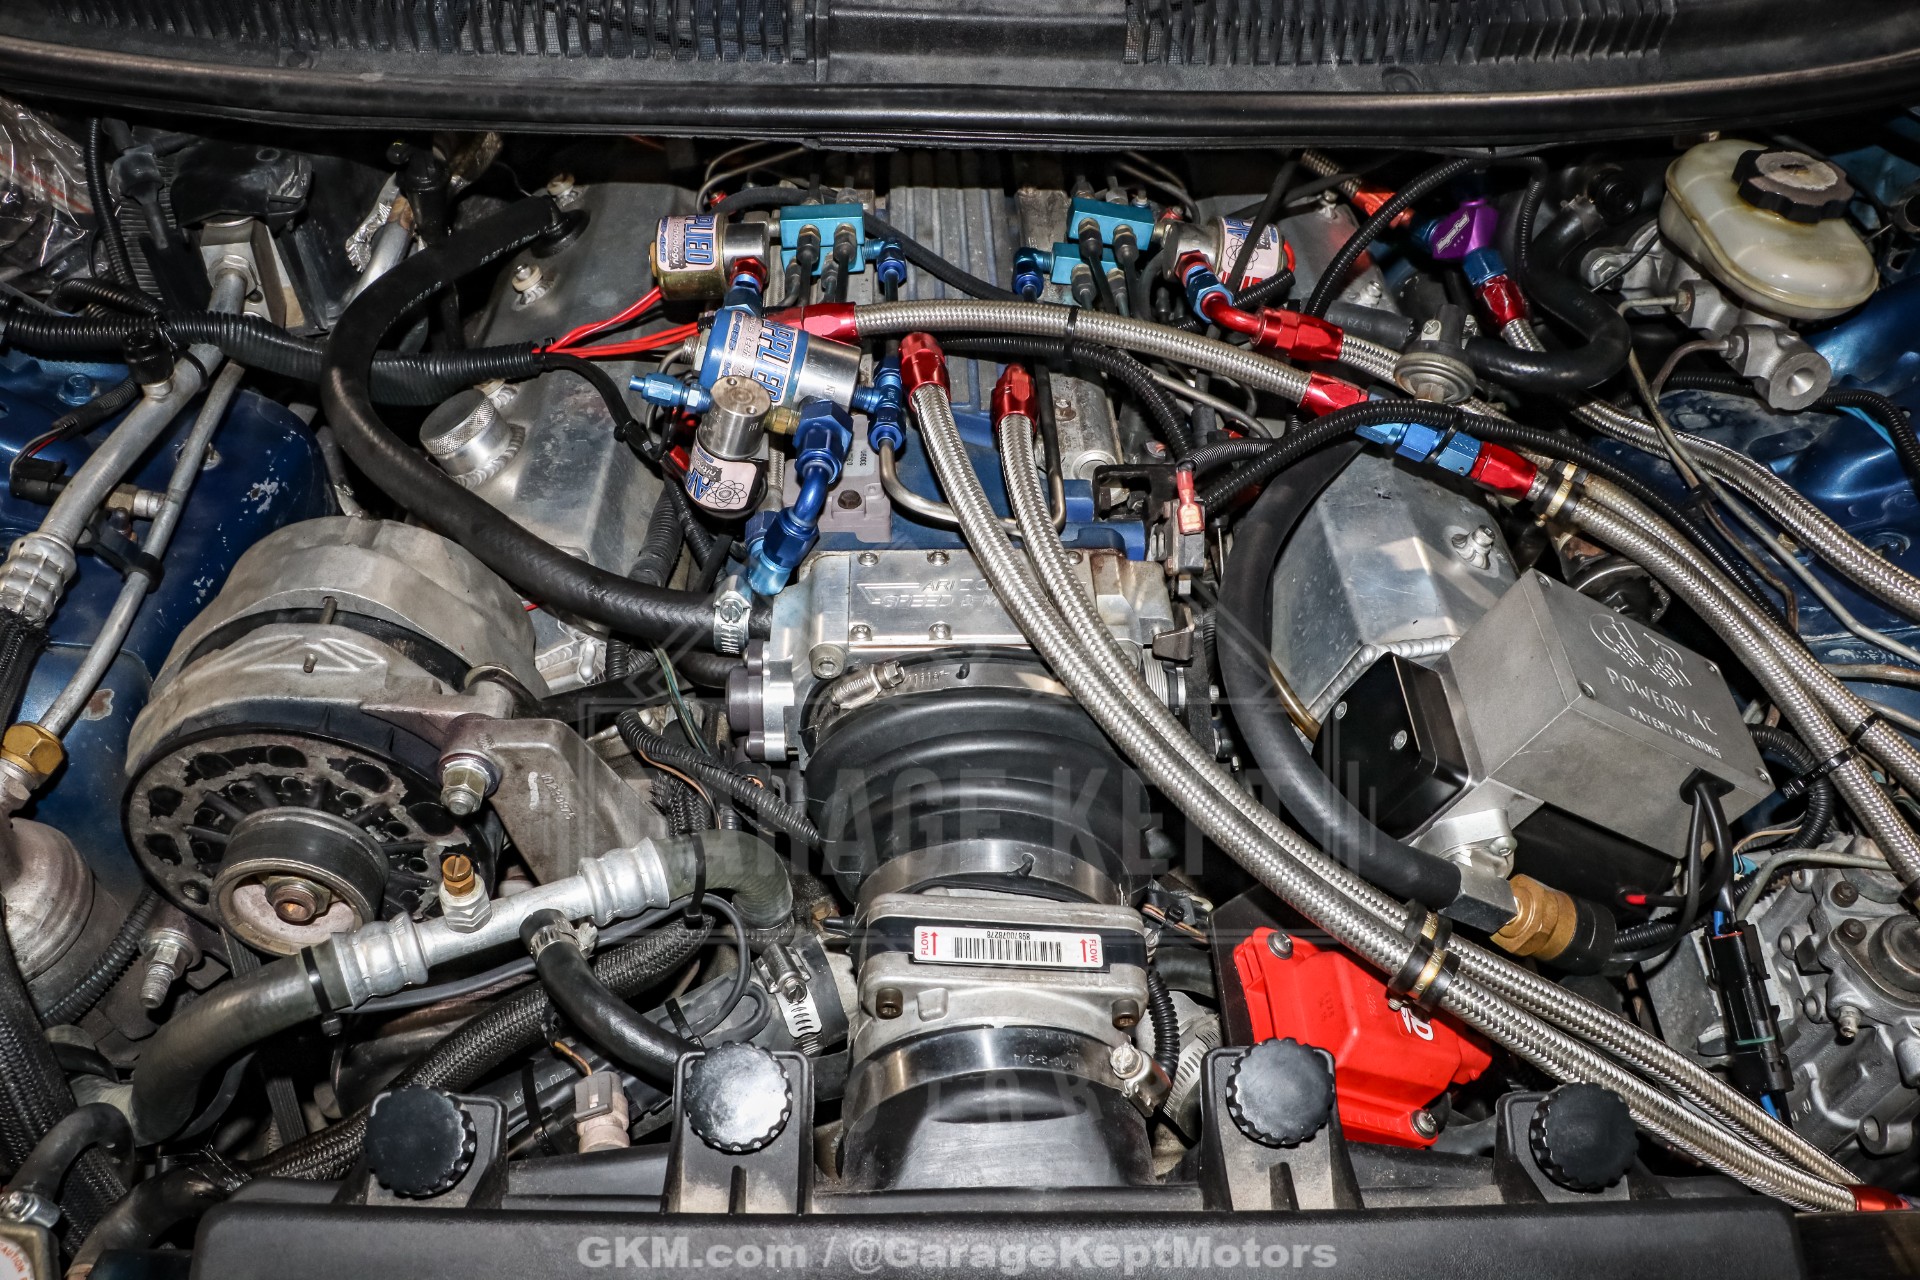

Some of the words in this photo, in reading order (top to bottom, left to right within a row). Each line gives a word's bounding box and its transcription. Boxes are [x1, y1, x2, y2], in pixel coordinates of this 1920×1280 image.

[1628, 706, 1673, 736] PATENT
[1675, 727, 1722, 759] PENDING
[920, 931, 929, 956] FLOW
[1089, 938, 1098, 963] FLOW
